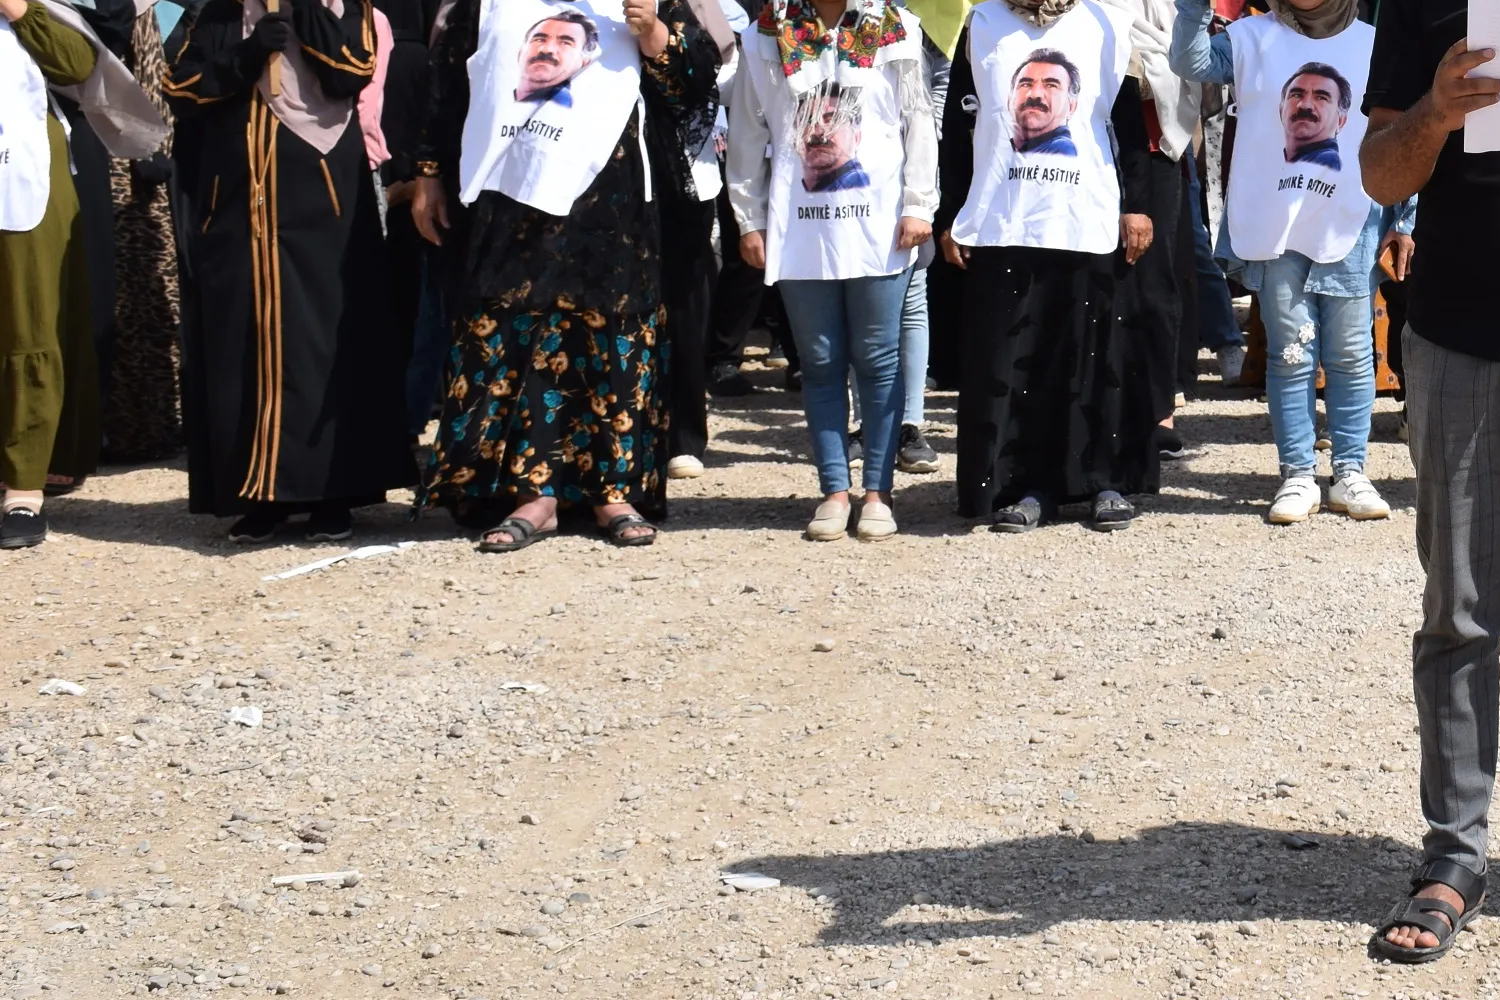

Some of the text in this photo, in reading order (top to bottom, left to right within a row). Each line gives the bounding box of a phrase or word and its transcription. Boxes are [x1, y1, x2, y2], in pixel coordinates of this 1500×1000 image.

[1008, 165, 1081, 185] DAYIKÊ AŞÎTIYÊ
[797, 204, 830, 219] DAYIKÊ
